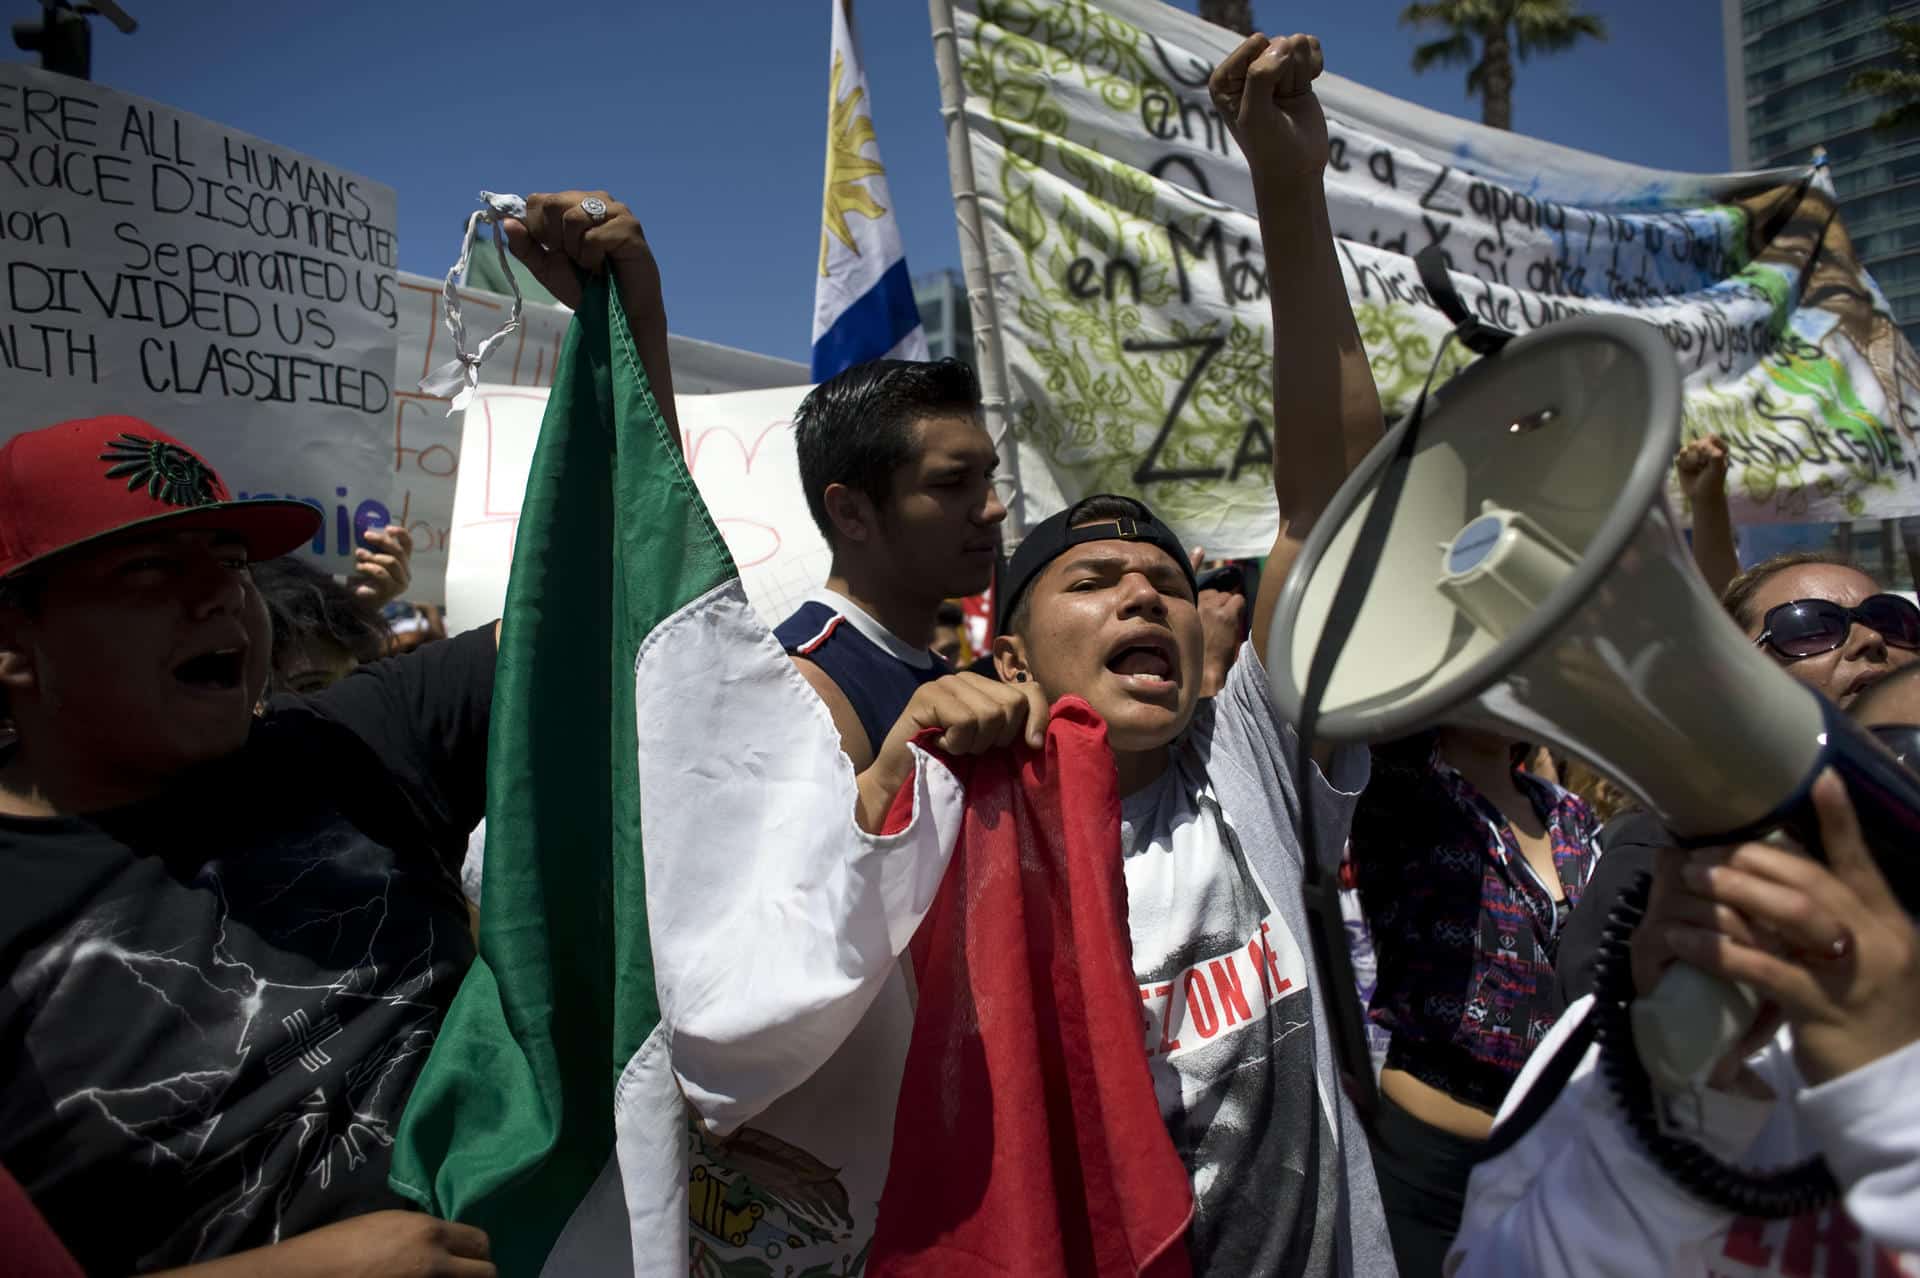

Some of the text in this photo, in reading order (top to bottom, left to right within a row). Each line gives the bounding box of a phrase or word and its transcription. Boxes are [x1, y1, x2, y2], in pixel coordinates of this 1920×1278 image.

[120, 105, 195, 167] ALL
[224, 137, 371, 222] HUMANS
[8, 262, 336, 350] DIVIDED US
[1067, 257, 1143, 303] en
[1162, 217, 1272, 306] Méx
[139, 337, 390, 414] CLASSIFIED
[1122, 333, 1273, 485] ZA
